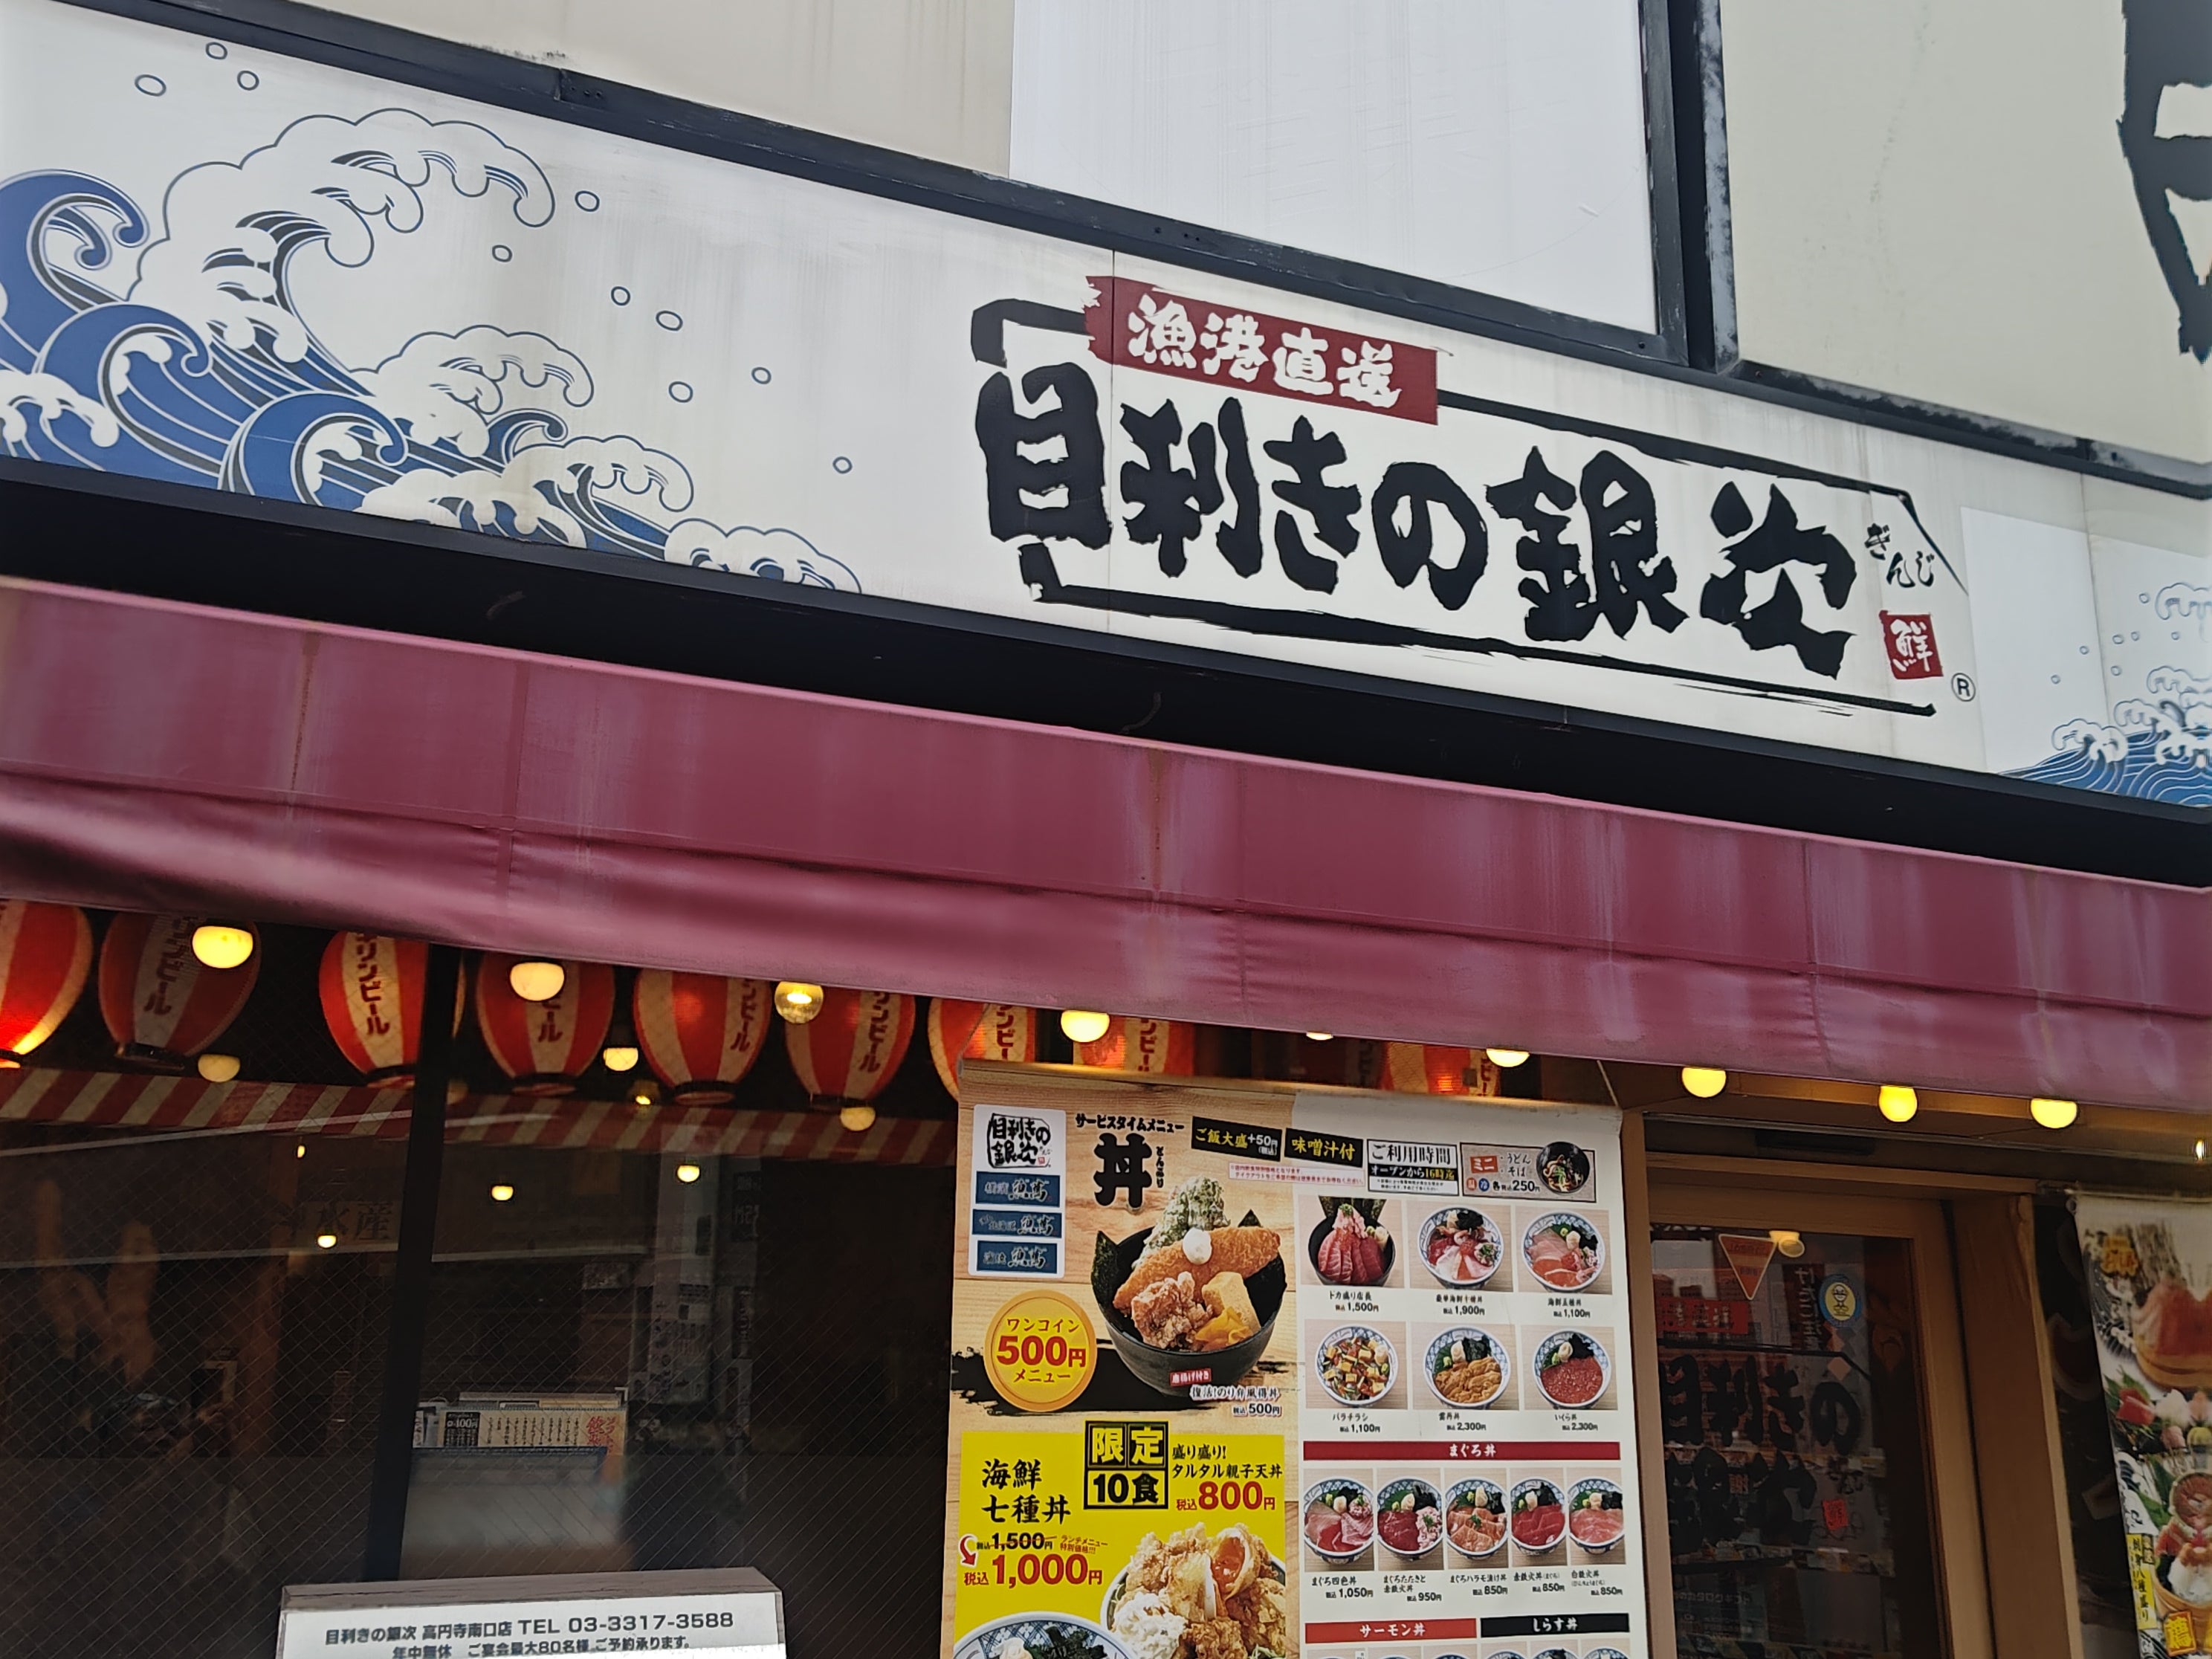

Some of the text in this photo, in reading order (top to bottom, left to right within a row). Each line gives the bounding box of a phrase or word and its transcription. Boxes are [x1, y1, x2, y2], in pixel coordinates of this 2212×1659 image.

[1128, 294, 1402, 408] 漁港直送
[975, 361, 1857, 680] 目利きの銀次
[1864, 523, 1935, 589] ぎんじ
[993, 1117, 1051, 1145] 目利きの
[1076, 1113, 1185, 1134] サービスタイムメニュー
[991, 1140, 1039, 1165] 銀次
[1291, 1136, 1356, 1162] 味噌汁付
[1372, 1144, 1451, 1165] ご利用時間
[1093, 1133, 1153, 1208] 丼
[1473, 1157, 1495, 1171] ミニ
[1006, 1317, 1081, 1333] ワンコイン
[996, 1335, 1087, 1368] 500円
[1012, 1368, 1072, 1385] メニュー
[1248, 1403, 1280, 1414] 500円
[1092, 1426, 1164, 1465] 限定
[1449, 1443, 1496, 1458] まぐろ丼
[981, 1458, 1042, 1490] 海鮮
[1172, 1463, 1284, 1481] タルタル親子天丼
[1093, 1472, 1160, 1504] 10食
[981, 1494, 1072, 1525] 七種丼
[1339, 1587, 1374, 1599] 1,050円
[1418, 1592, 1442, 1602] 950円
[1484, 1585, 1508, 1595] 850円
[1542, 1583, 1565, 1592] 850円
[1600, 1586, 1623, 1596] 850円
[326, 1625, 417, 1645] 目利きの銀次
[517, 1618, 560, 1635] TEL
[568, 1612, 734, 1633] 03-3317-3588
[1359, 1621, 1426, 1638] サーモン丼
[1531, 1617, 1579, 1632] しらす丼
